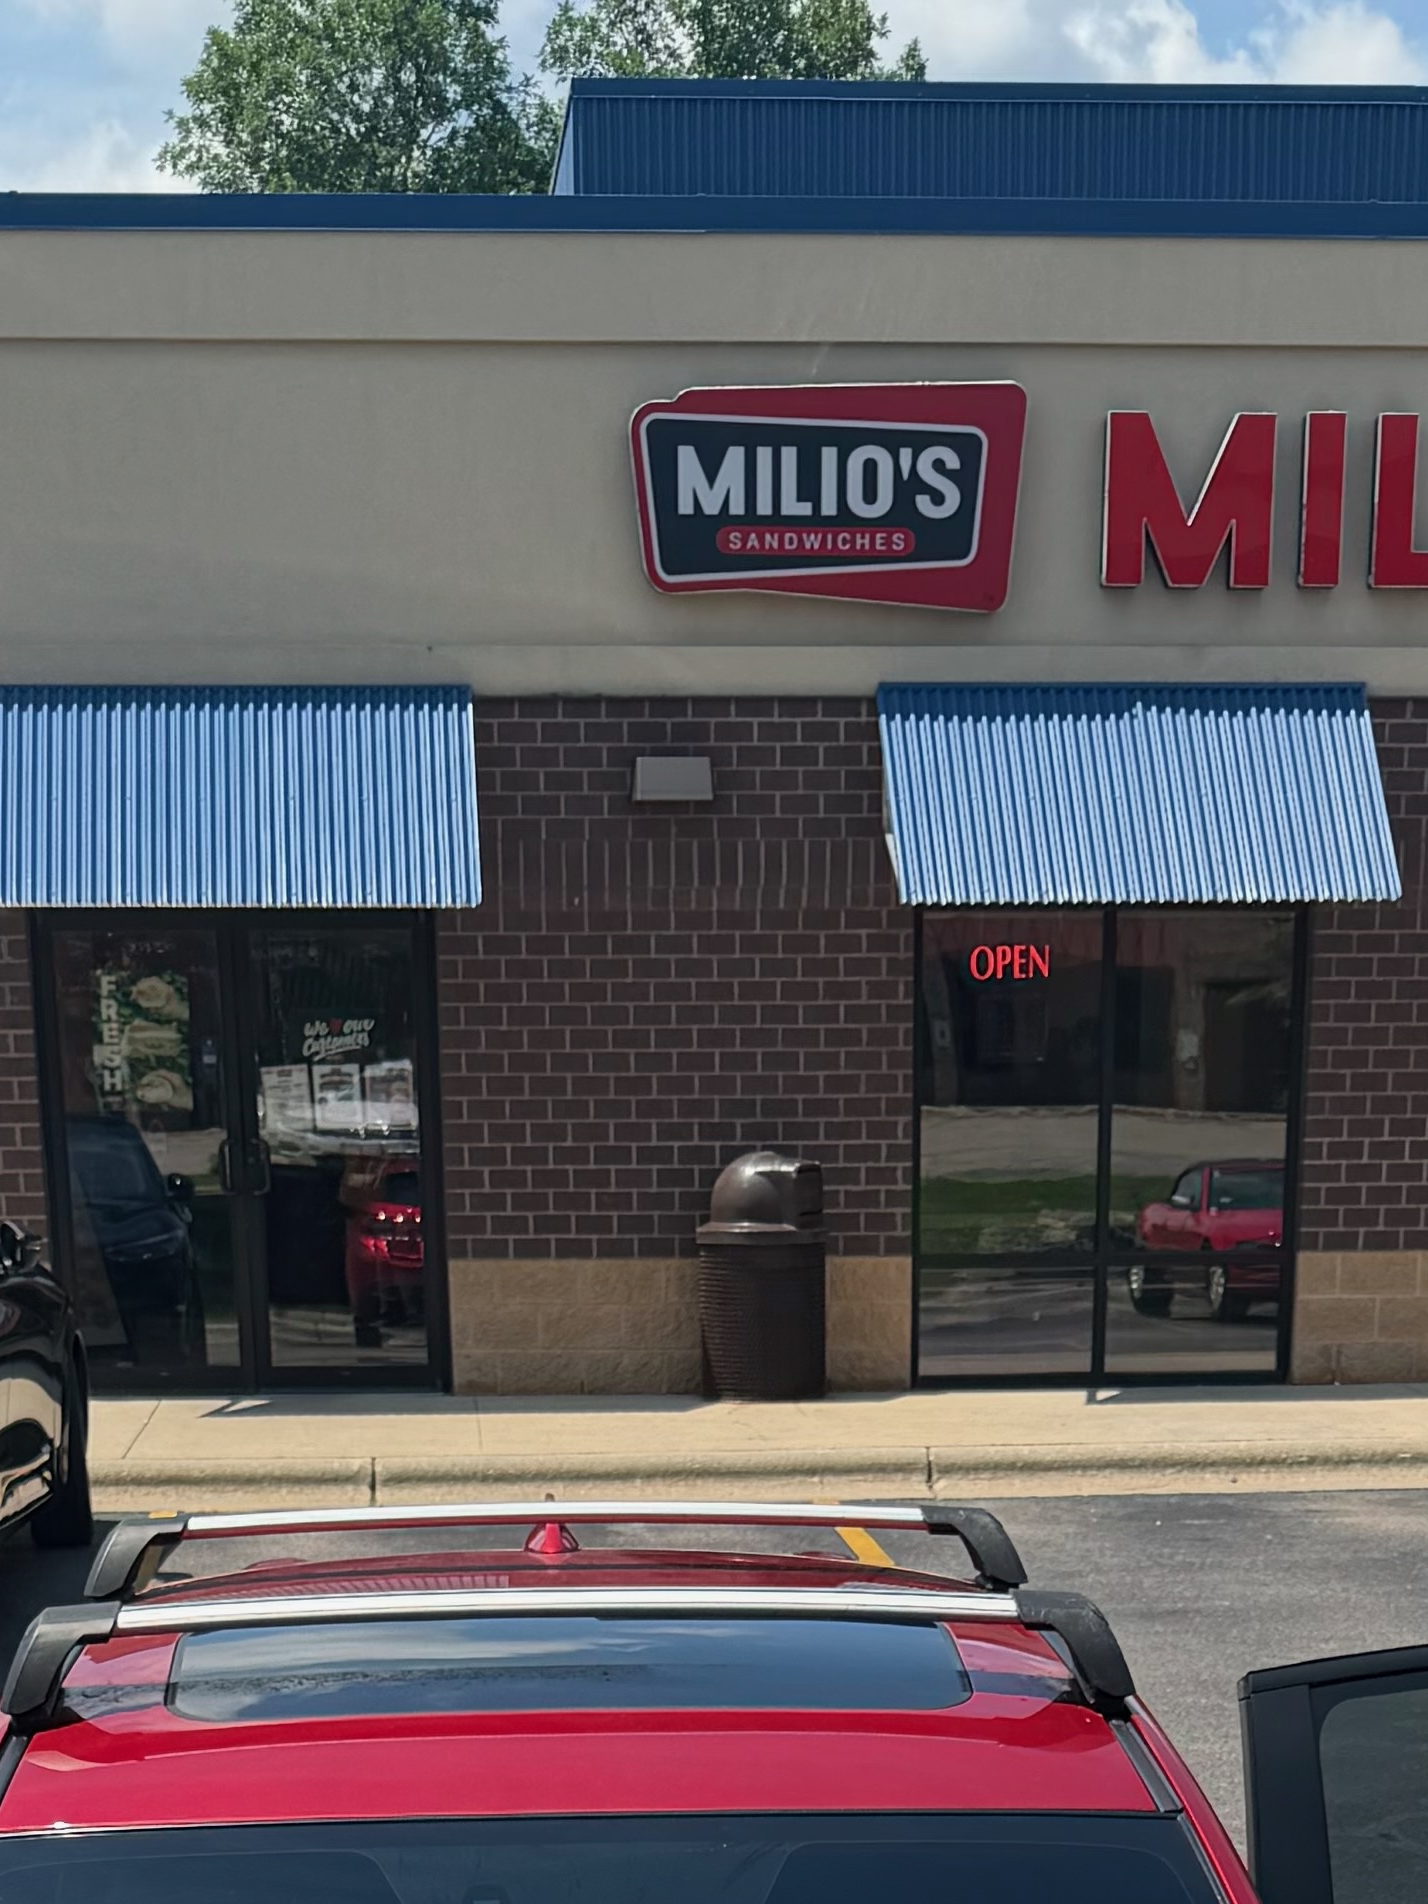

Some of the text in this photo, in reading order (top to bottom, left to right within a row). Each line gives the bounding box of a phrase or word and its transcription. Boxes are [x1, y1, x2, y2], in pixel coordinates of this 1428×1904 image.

[677, 445, 962, 519] MILIO'S
[728, 532, 906, 551] SANDWICHES
[969, 945, 1050, 981] OPEN
[100, 975, 124, 1092] FRESH
